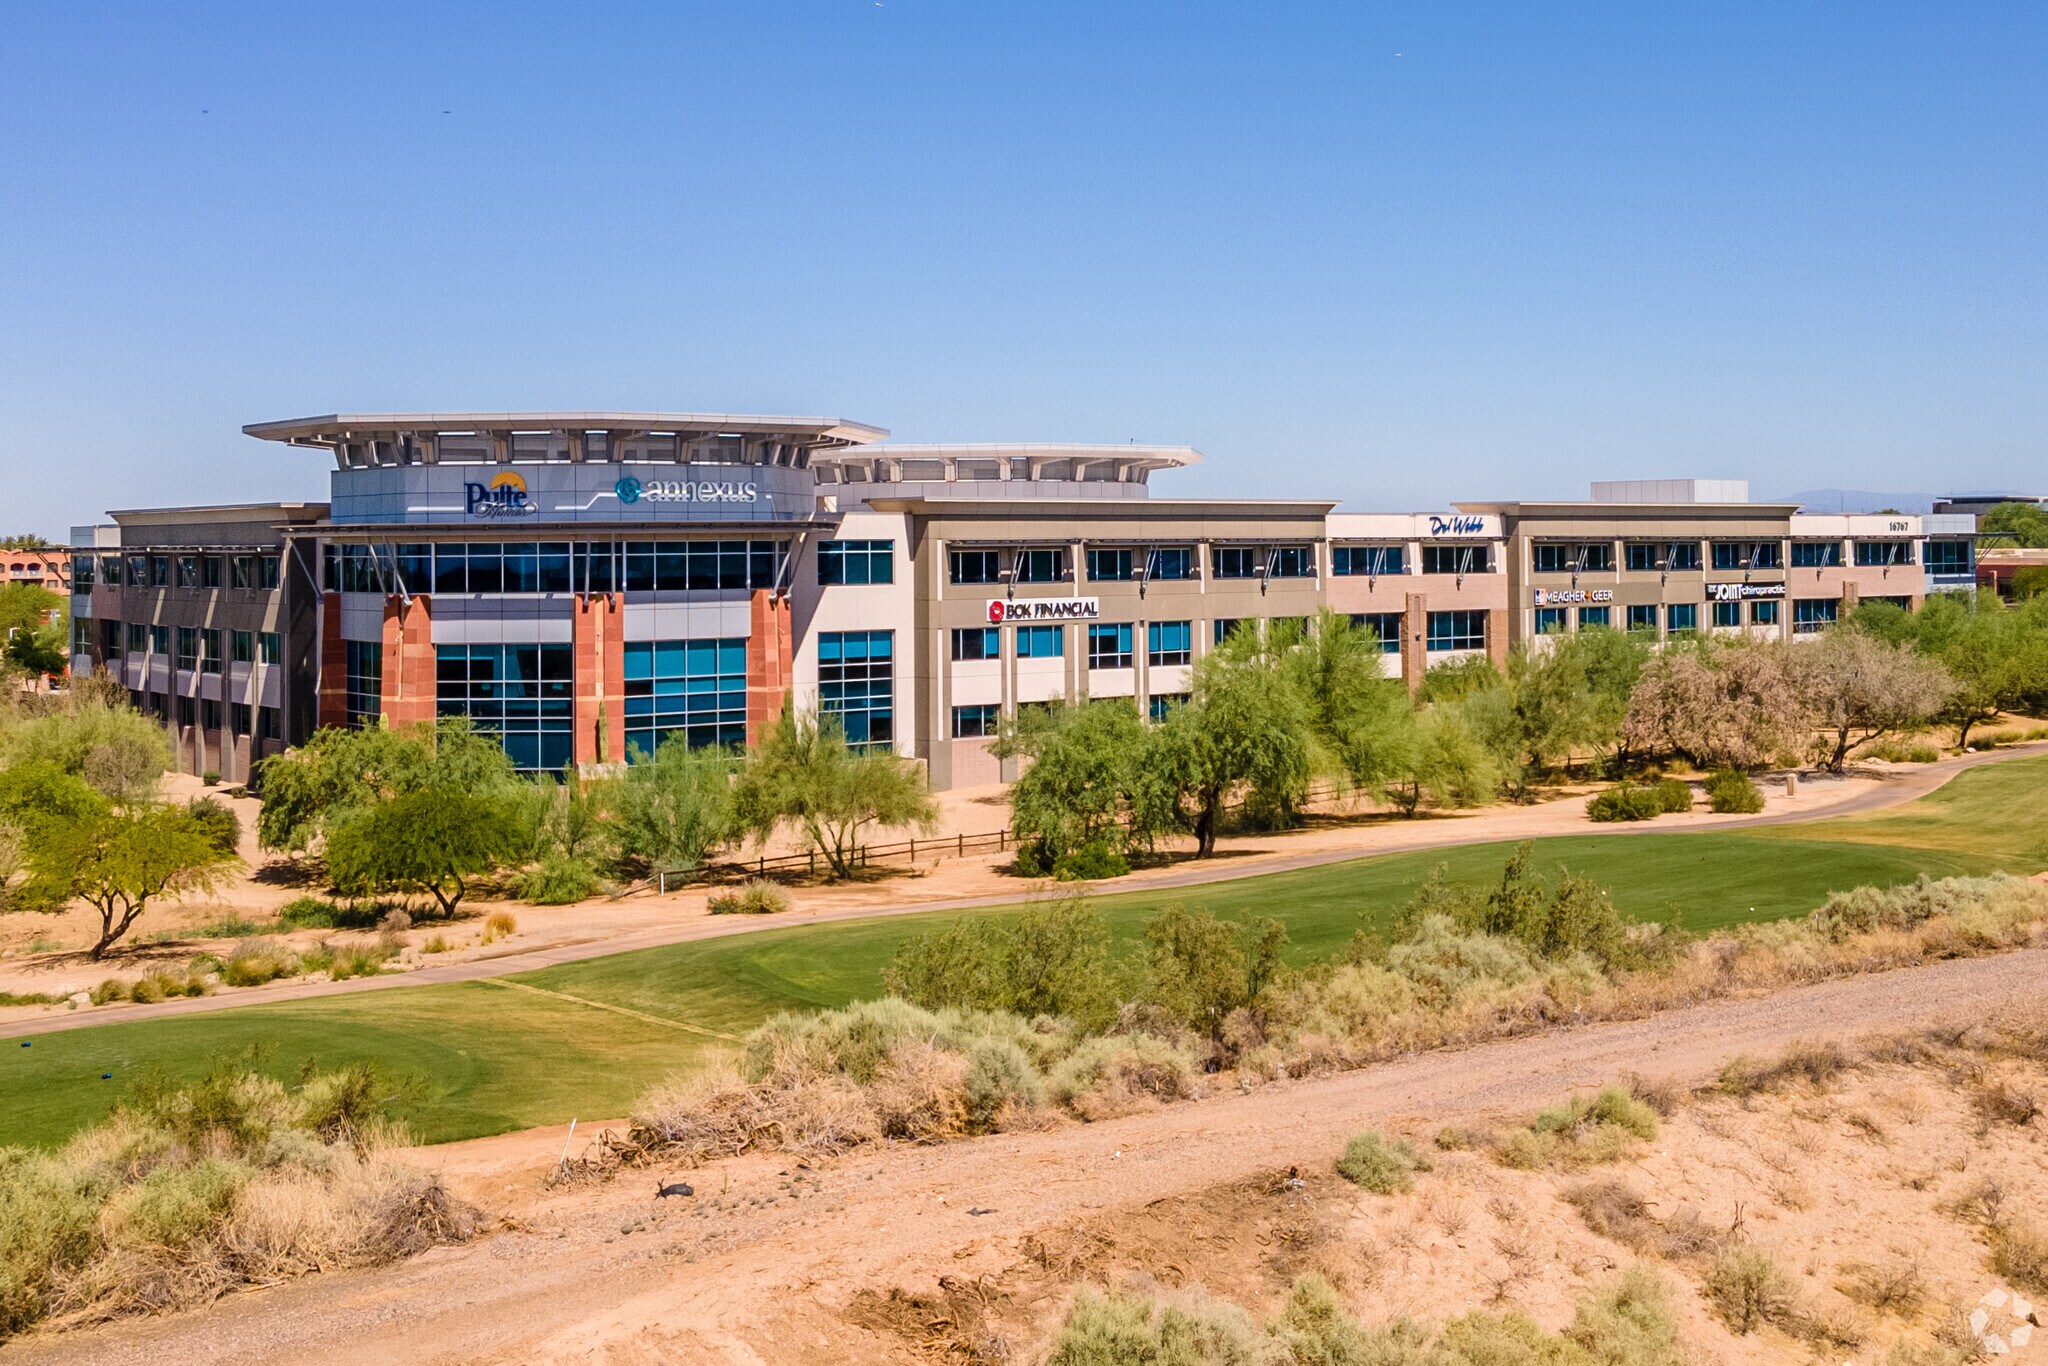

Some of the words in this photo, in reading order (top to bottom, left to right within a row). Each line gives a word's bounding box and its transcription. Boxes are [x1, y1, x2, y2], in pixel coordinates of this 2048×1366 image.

[464, 482, 528, 514] Pulte
[646, 480, 757, 503] annexus
[475, 501, 539, 519] Homes
[1889, 521, 1908, 531] 16767
[1546, 591, 1585, 603] MEAGHER
[1592, 590, 1613, 602] GEER
[1715, 584, 1743, 600] JOINT
[1741, 585, 1786, 596] chiropractic
[1006, 603, 1031, 619] BOK
[1034, 602, 1098, 618] FINANCIAL
